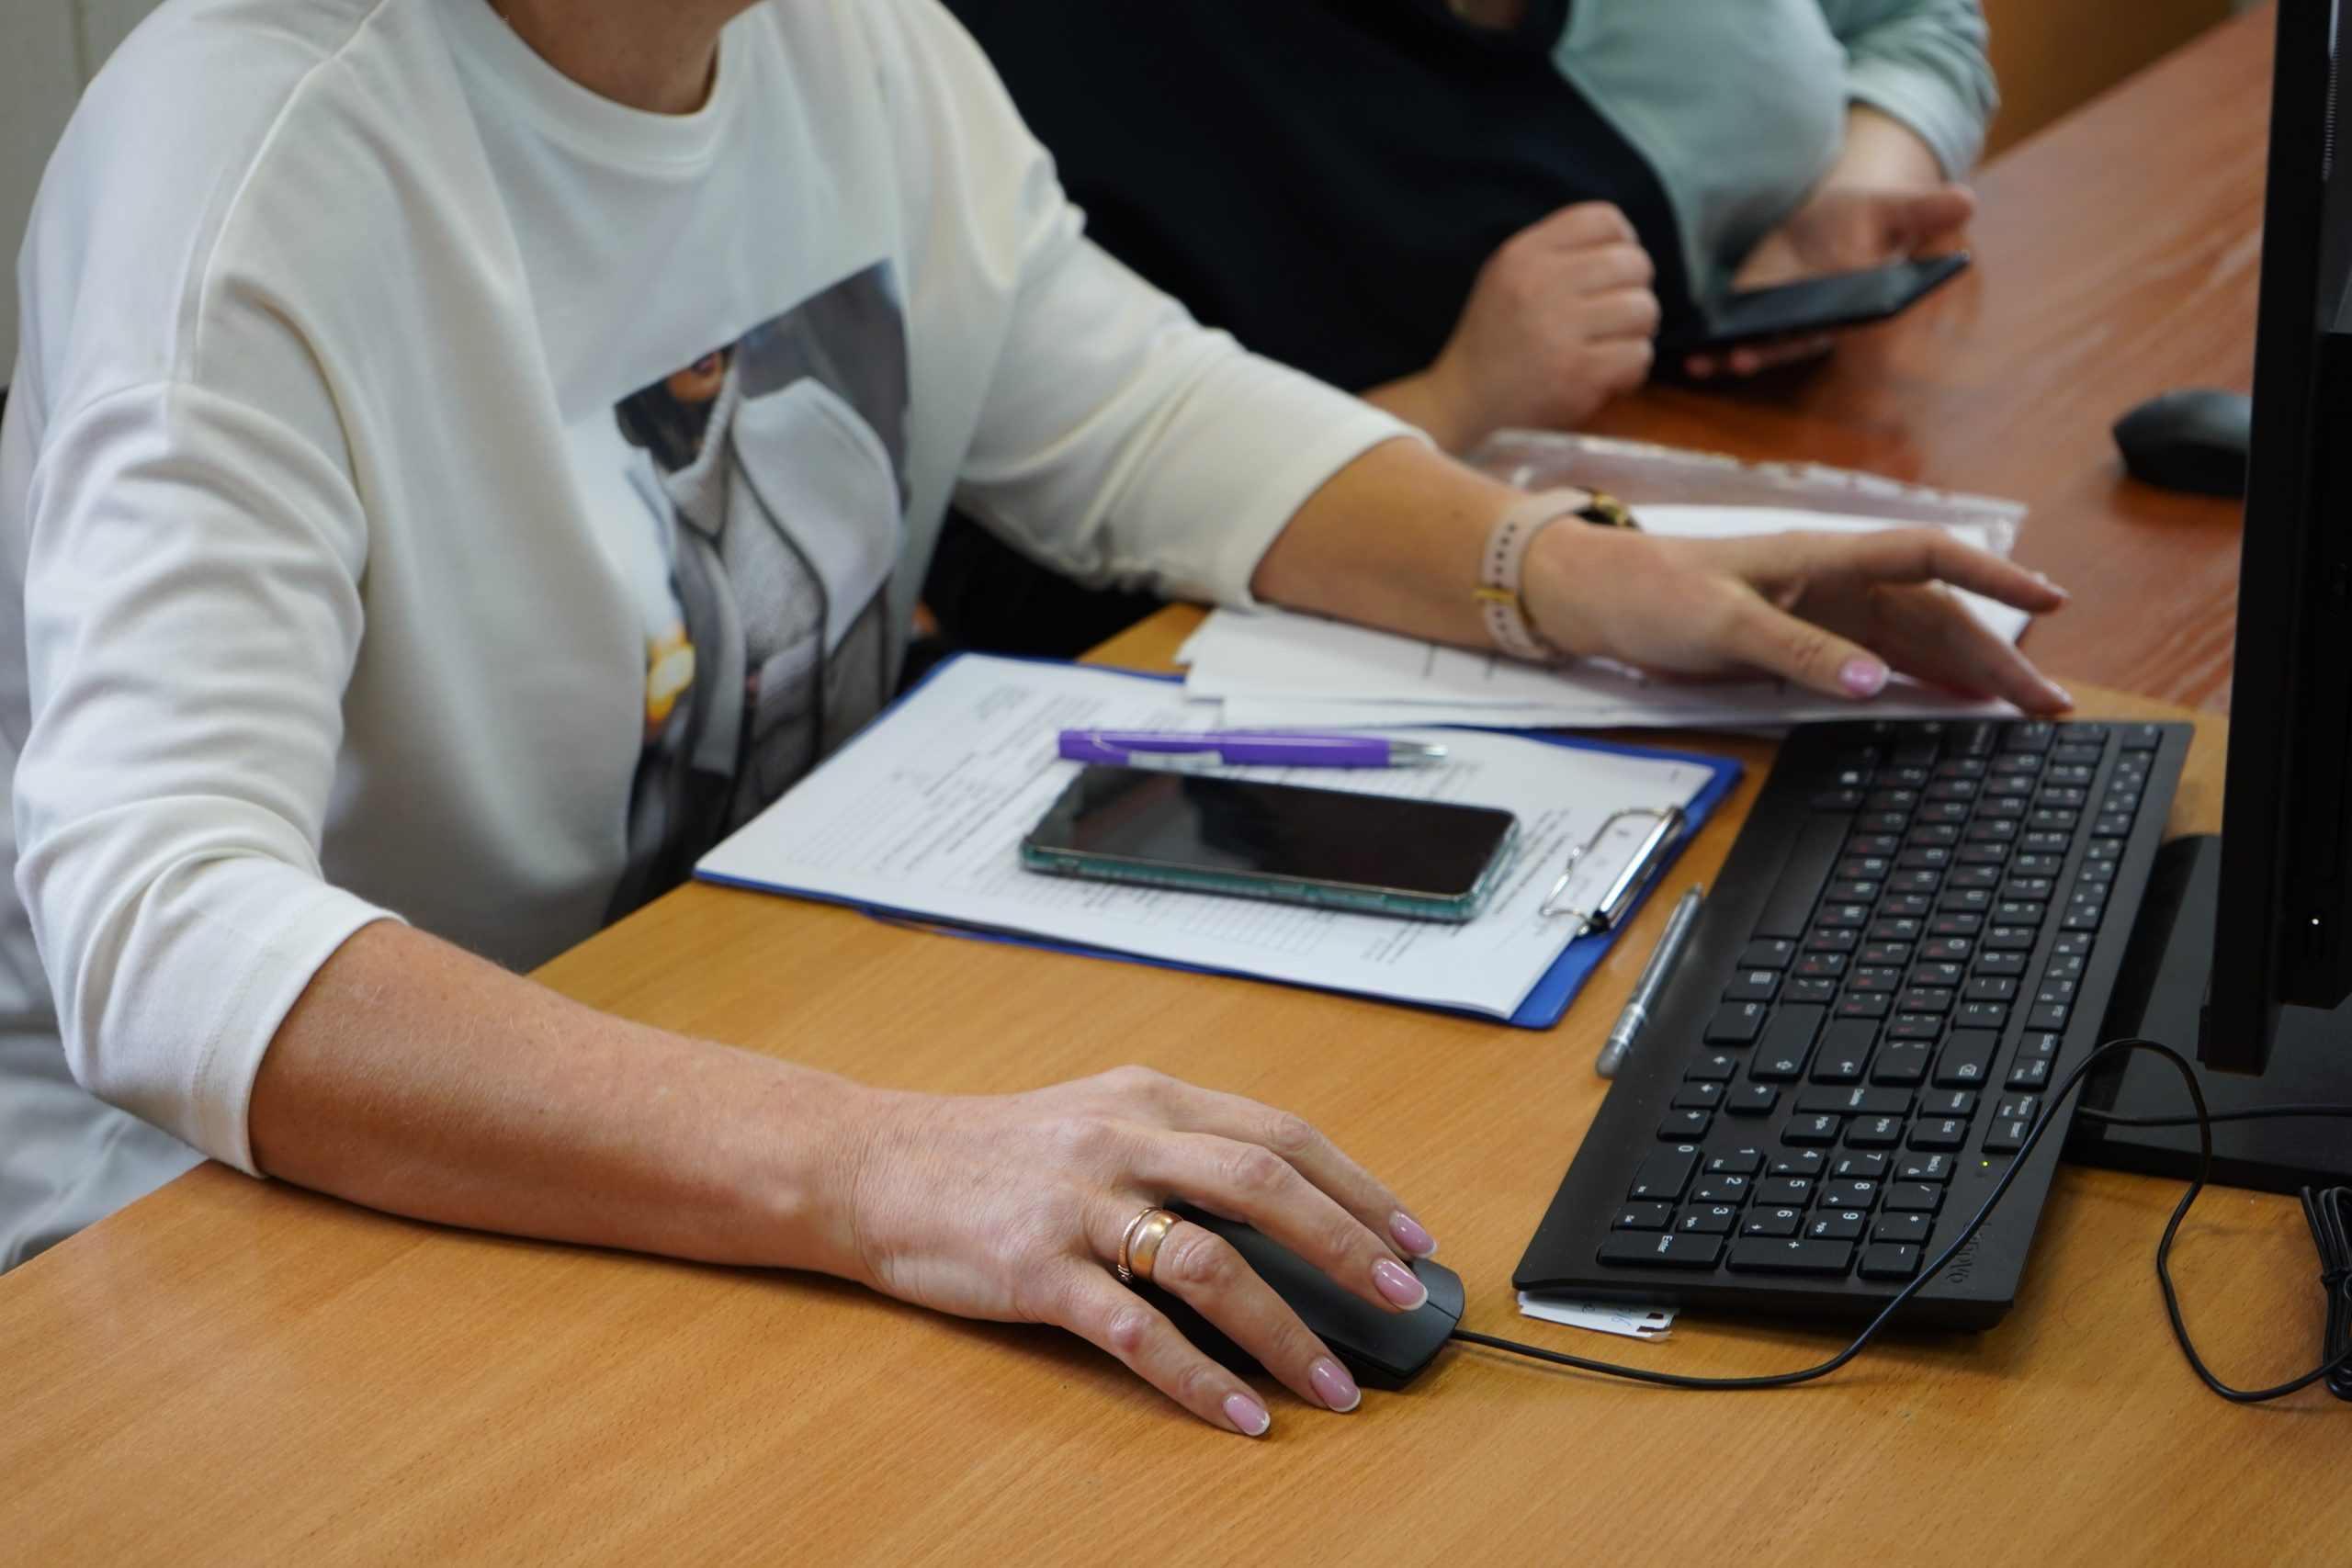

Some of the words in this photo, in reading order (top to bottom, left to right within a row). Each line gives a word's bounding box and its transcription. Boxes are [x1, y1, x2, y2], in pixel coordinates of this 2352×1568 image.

[1966, 891, 1983, 901] U
[1896, 920, 1913, 930] K
[1886, 944, 1904, 953] L
[1948, 940, 1966, 950] O
[1940, 964, 1956, 974] P
[2018, 1096, 2033, 1115] Pause
[1942, 1121, 1955, 1133] End
[1679, 1145, 1694, 1153] 0
[1803, 1150, 1818, 1158] 4
[1867, 1153, 1887, 1161] 7
[1726, 1177, 1742, 1185] 2
[1854, 1182, 1871, 1190] 8
[1777, 1210, 1792, 1218] 6
[1657, 1235, 1673, 1253] Enter
